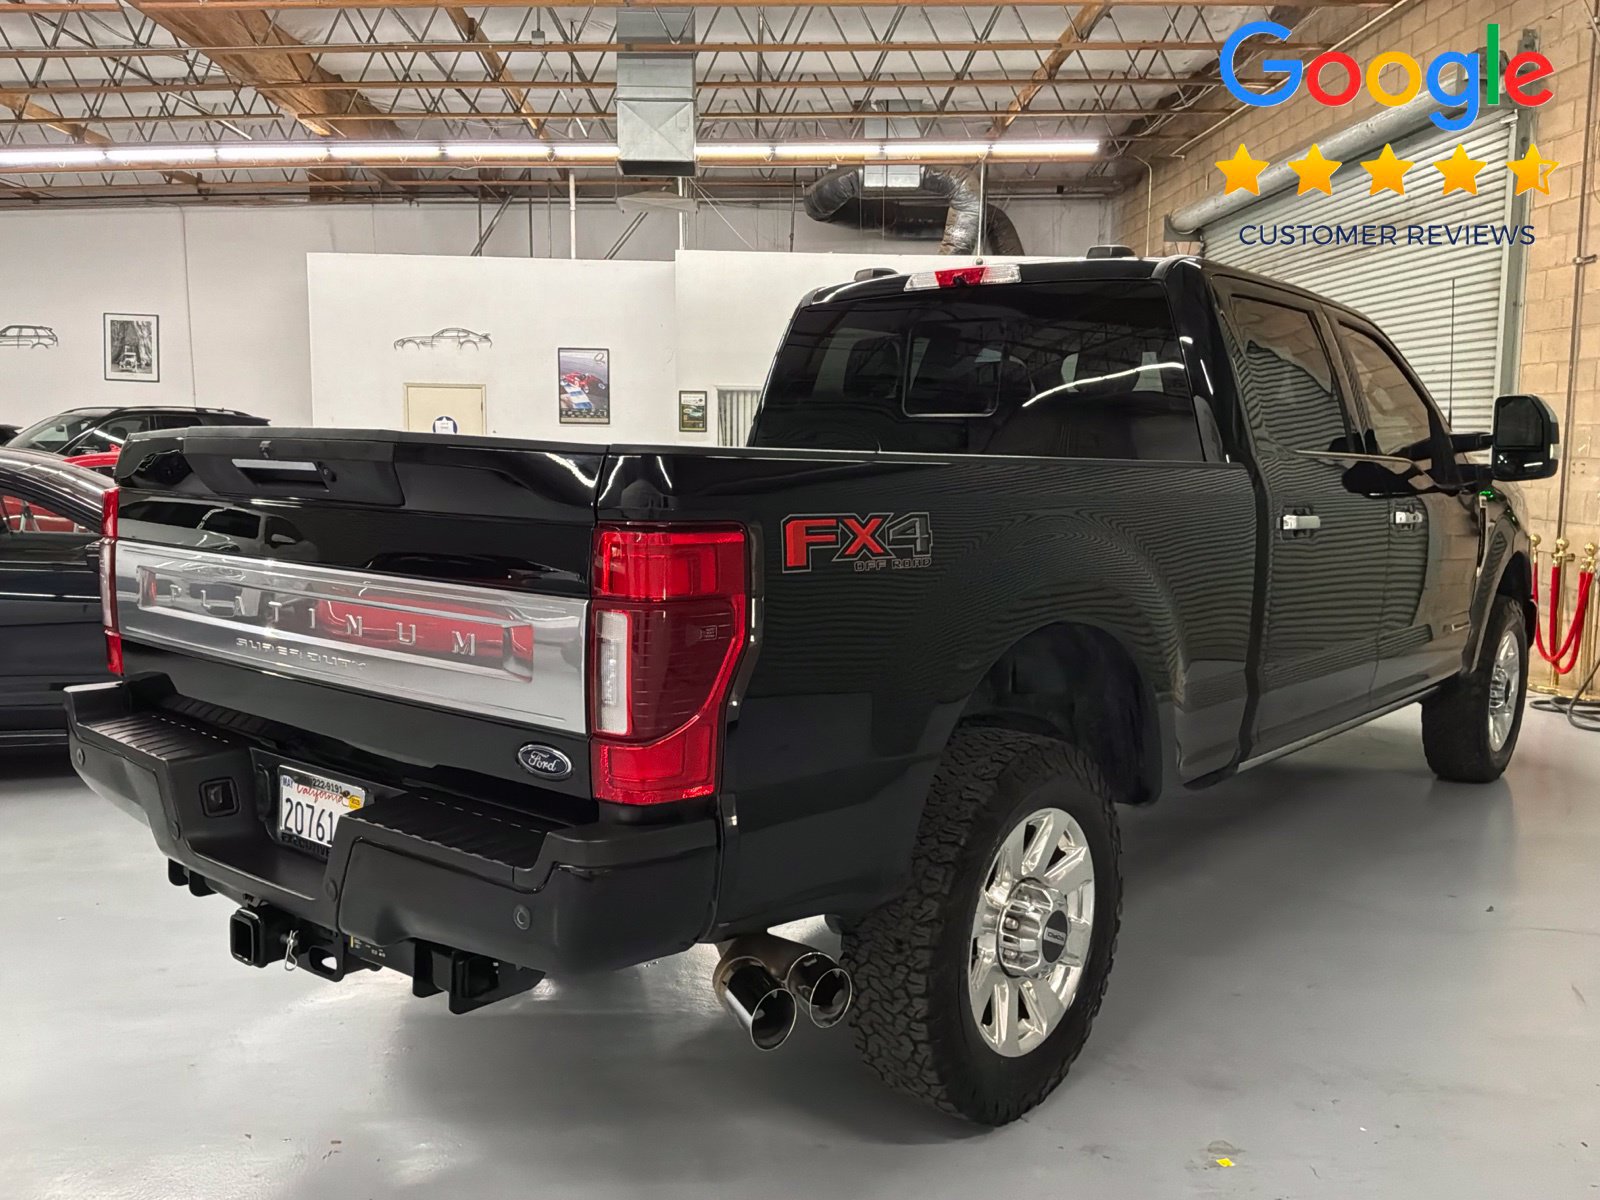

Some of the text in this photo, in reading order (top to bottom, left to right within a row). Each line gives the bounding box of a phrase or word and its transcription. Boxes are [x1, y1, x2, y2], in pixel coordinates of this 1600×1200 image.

[780, 512, 933, 573] FX4
[854, 558, 932, 571] OFF ROAD
[169, 584, 476, 656] PLATINUM
[235, 637, 302, 658] SUPER
[528, 750, 560, 771] Ford
[282, 777, 294, 789] MAY
